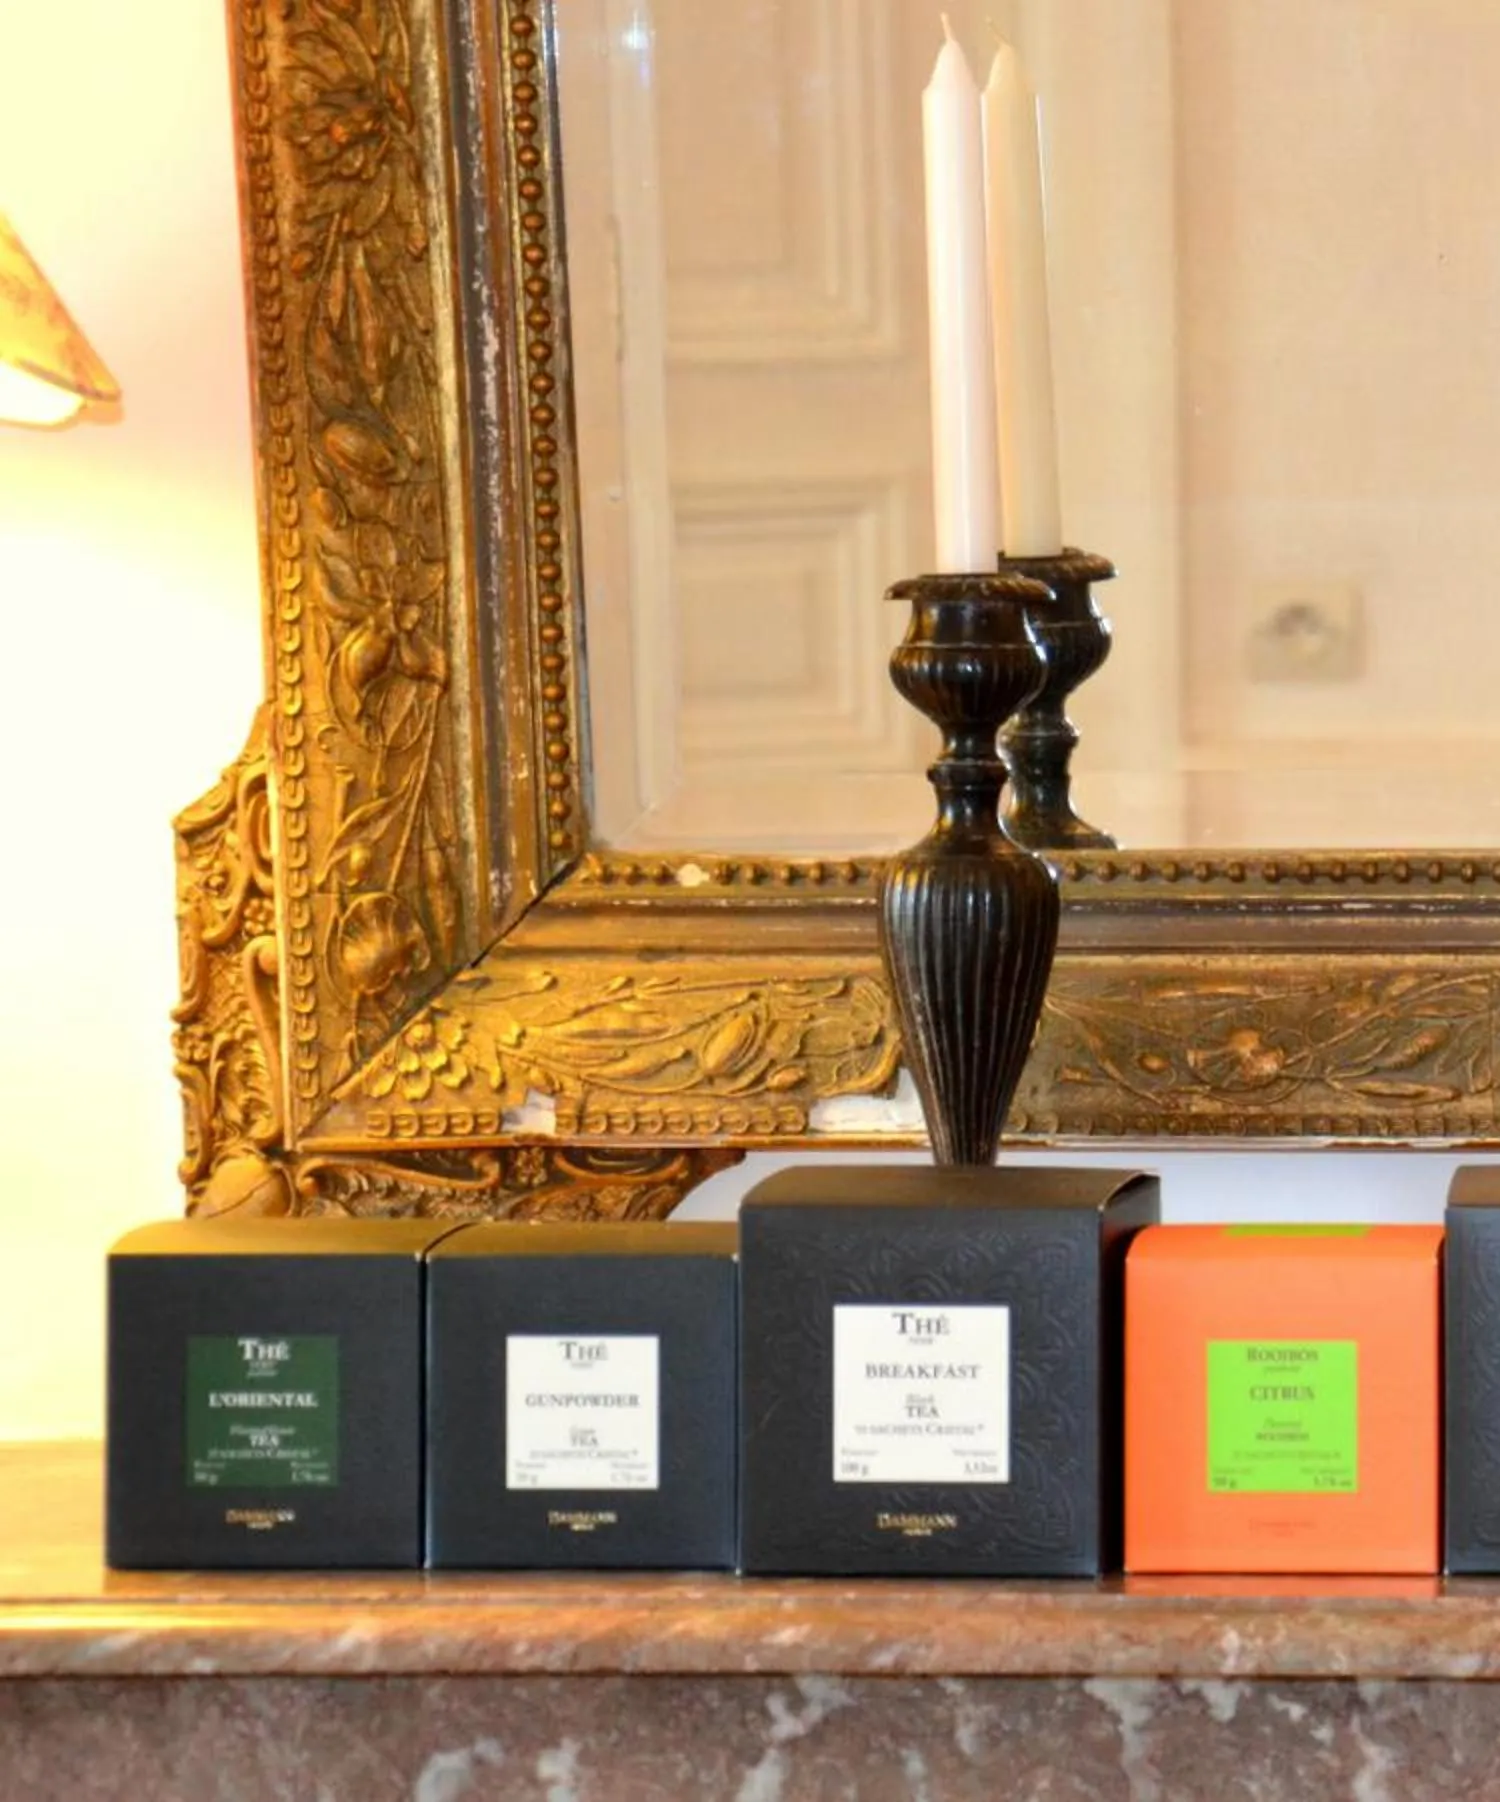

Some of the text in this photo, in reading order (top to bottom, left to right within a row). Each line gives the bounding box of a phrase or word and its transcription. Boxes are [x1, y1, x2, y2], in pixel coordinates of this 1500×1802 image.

[1247, 1347, 1318, 1362] ROOIBOS
[865, 1363, 981, 1379] BREAKFAST
[208, 1392, 318, 1408] L'ORIENTAL
[525, 1393, 640, 1408] GUNPOWDER
[1249, 1386, 1315, 1401] CITRUS
[905, 1405, 939, 1419] TEA
